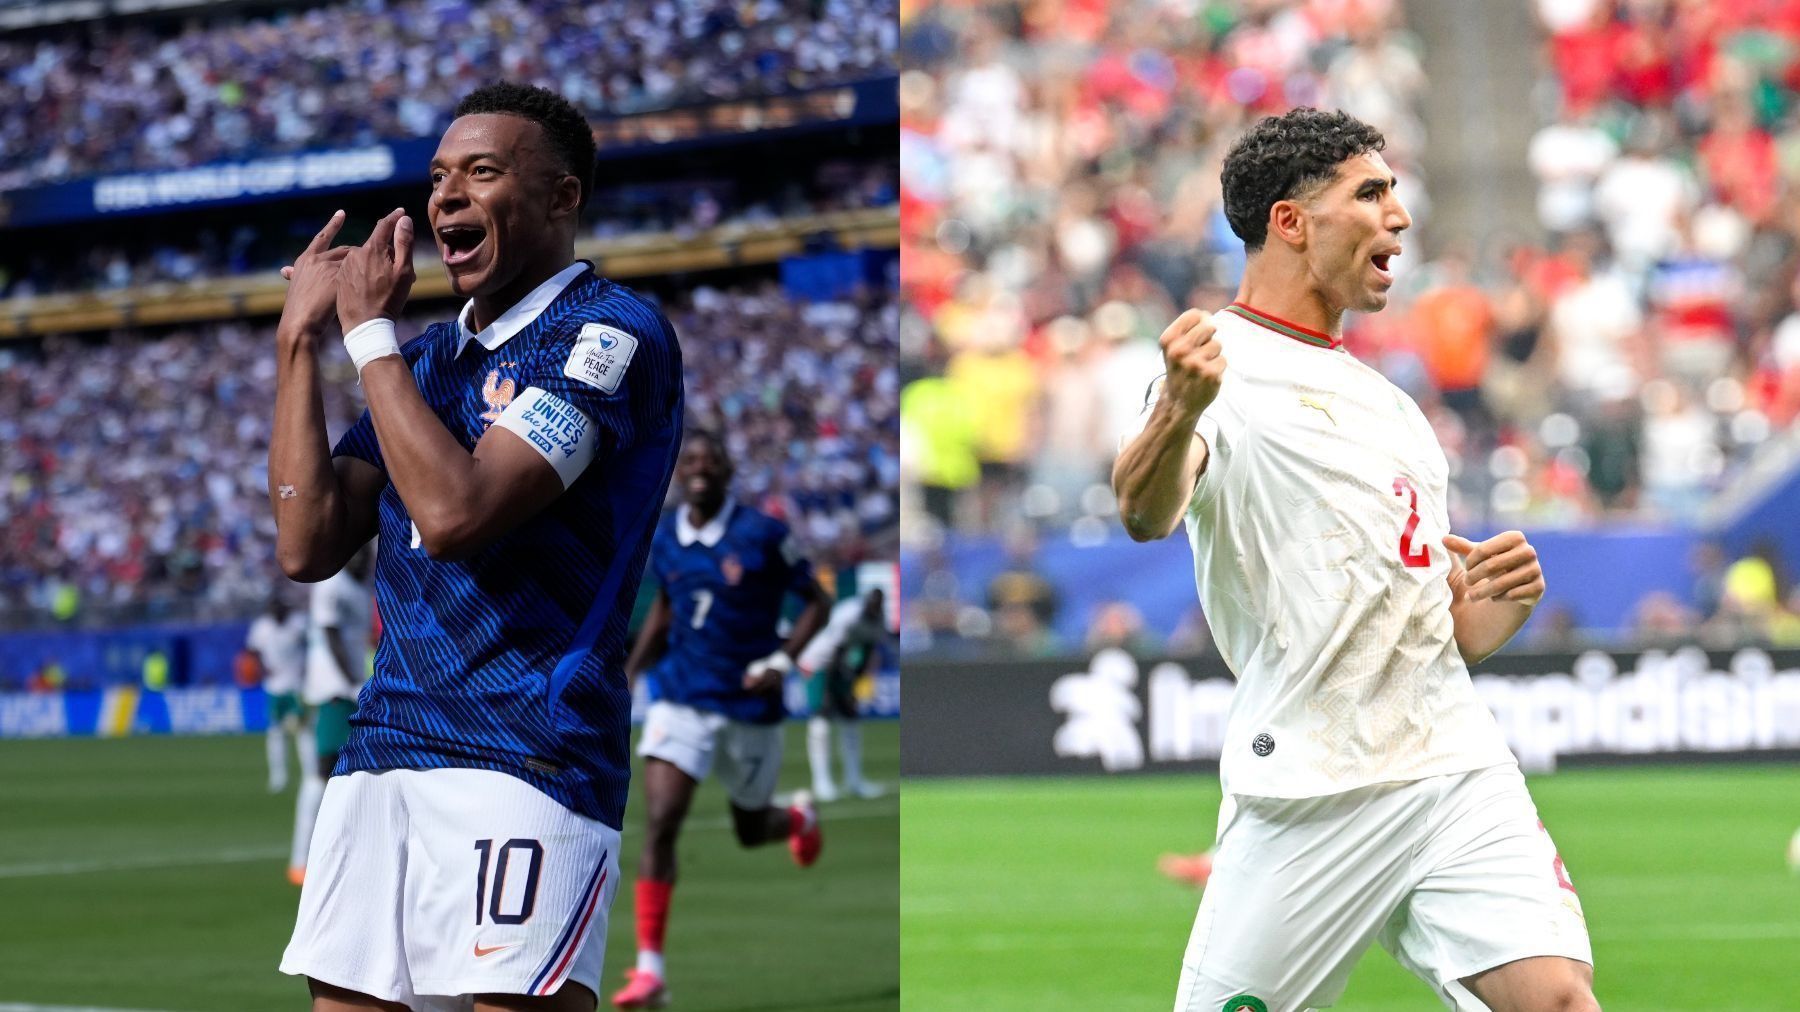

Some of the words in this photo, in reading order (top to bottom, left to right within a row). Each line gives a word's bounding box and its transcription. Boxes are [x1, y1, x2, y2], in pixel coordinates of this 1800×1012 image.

[583, 357, 611, 376] PEACE
[586, 346, 604, 360] Unite
[585, 369, 599, 380] FIFA
[532, 398, 583, 445] UNITES
[542, 391, 588, 432] FOOTBALL
[521, 409, 540, 427] the
[540, 422, 577, 459] World
[528, 430, 553, 453] FIFA
[1392, 477, 1431, 567] 2
[691, 590, 713, 630] 7
[741, 756, 765, 786] 7
[474, 838, 544, 925] 10
